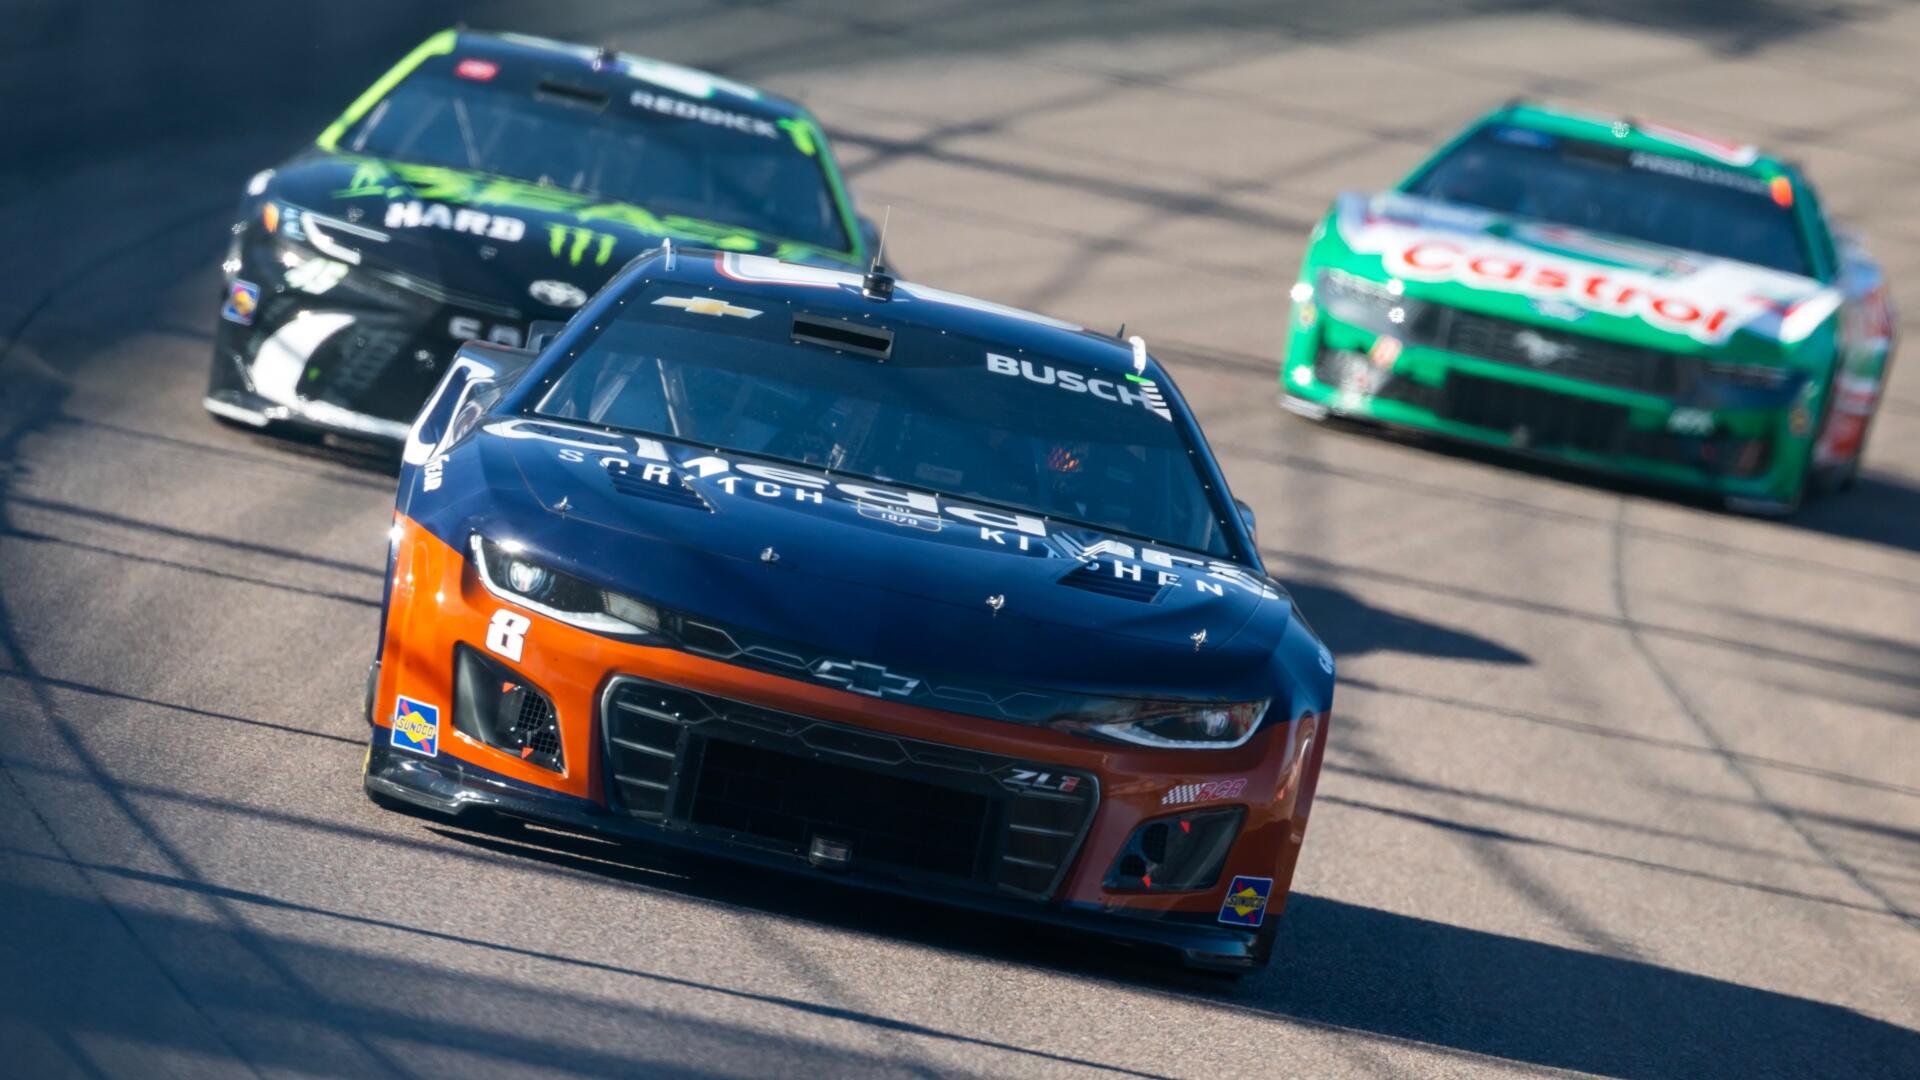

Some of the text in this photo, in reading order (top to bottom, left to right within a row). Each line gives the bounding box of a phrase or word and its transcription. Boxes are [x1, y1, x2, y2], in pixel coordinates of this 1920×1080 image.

[630, 90, 778, 139] REDDICK
[384, 201, 526, 242] HARD
[1402, 239, 1729, 333] Castrol
[986, 352, 1155, 412] BUSCH
[558, 448, 823, 504] SCRTCH
[485, 607, 532, 664] 8
[396, 717, 436, 739] SUNOCO
[1002, 768, 1081, 793] ZL1
